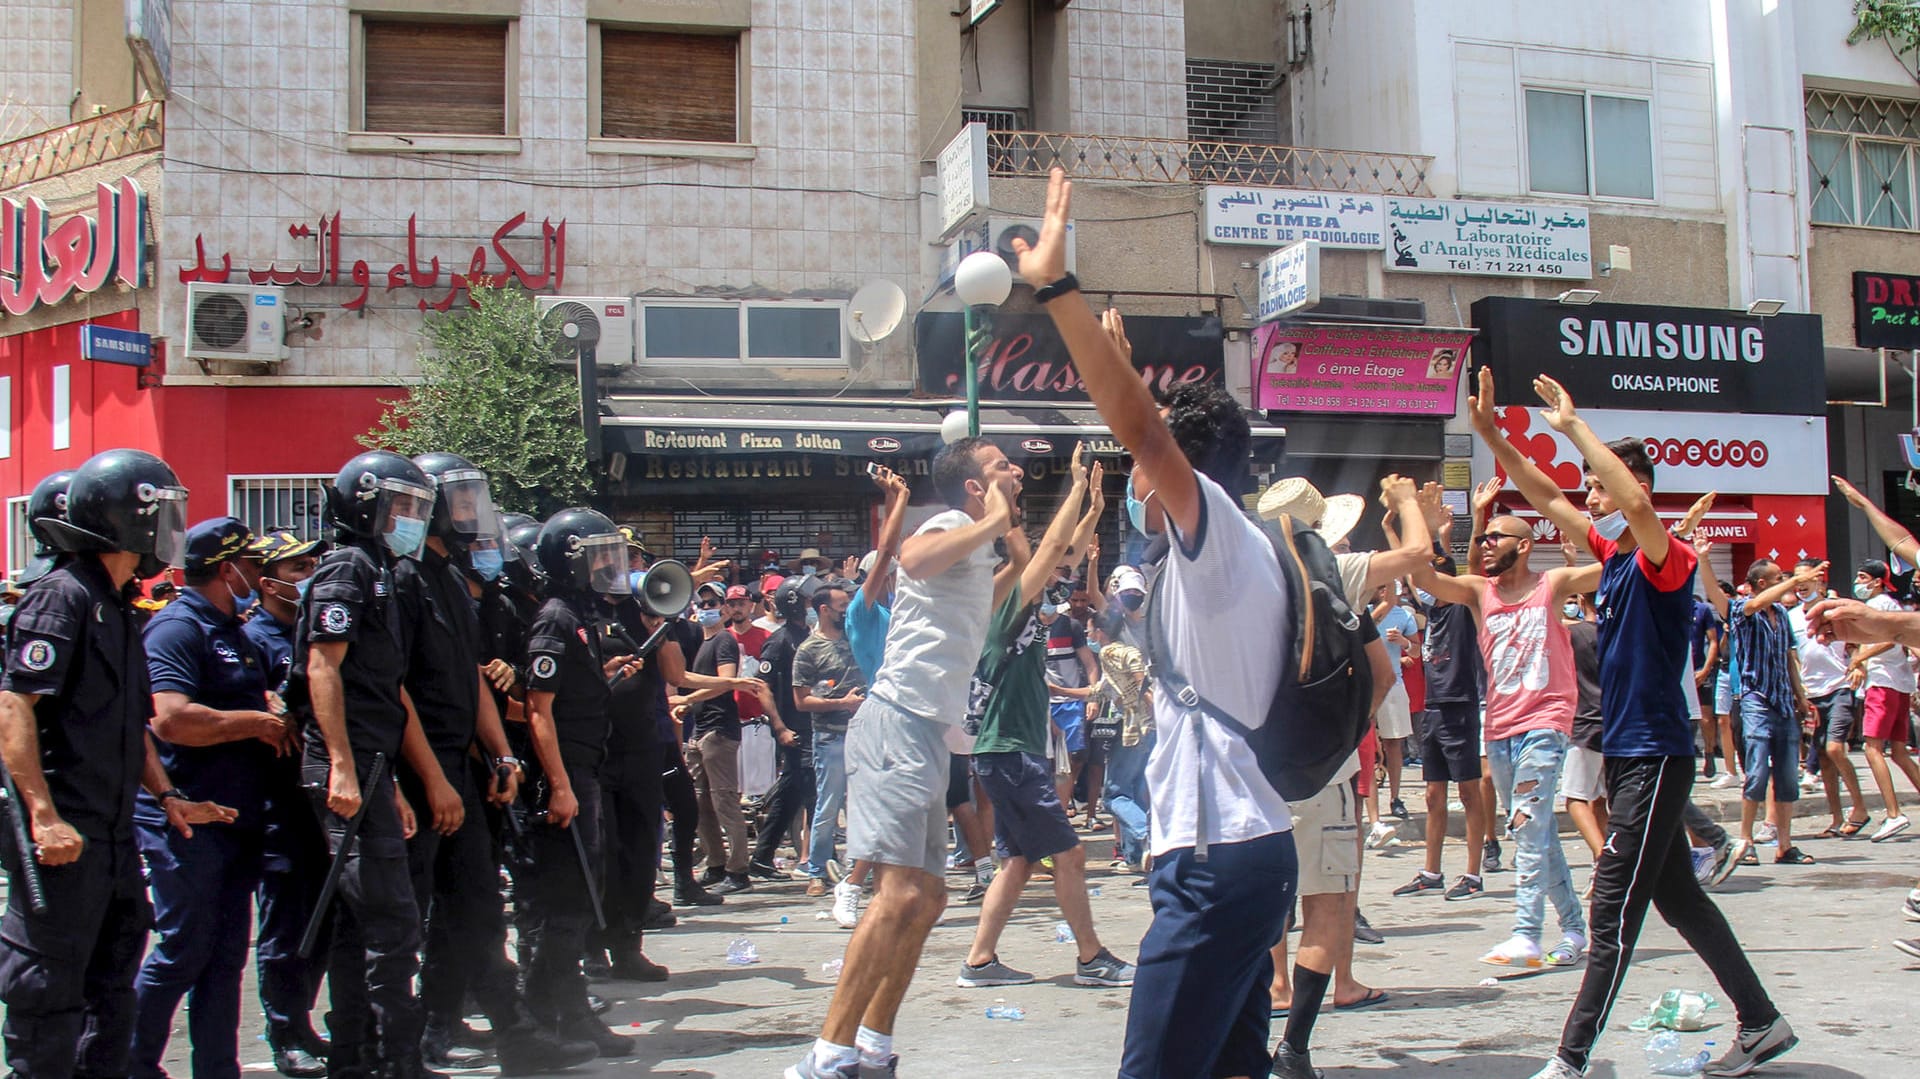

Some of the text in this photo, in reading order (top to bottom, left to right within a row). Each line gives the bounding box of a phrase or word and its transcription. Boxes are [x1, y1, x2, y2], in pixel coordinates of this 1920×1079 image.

[1218, 191, 1374, 214] مركز التصوير الطبي
[1256, 213, 1341, 229] CIMBA
[1389, 201, 1586, 232] مخبر التحاليل الطبية
[1214, 226, 1380, 245] CENTRE DE RADIOLOGIE
[1456, 228, 1552, 246] Laboratoire
[387, 211, 566, 312] الكهرباء
[1506, 245, 1589, 263] Médicales
[1448, 260, 1470, 271] Tél
[1485, 261, 1501, 272] 71
[1508, 263, 1532, 273] 221
[1537, 264, 1563, 275] 450
[1260, 284, 1306, 317] RADIOLOGIE
[1864, 276, 1920, 307] DR
[95, 337, 147, 354] SAMSUNG
[1559, 317, 1765, 363] SAMSUNG
[1304, 343, 1351, 357] Coiffure
[1353, 346, 1366, 357] et
[1317, 360, 1406, 378] 6 ème Étage
[1611, 374, 1720, 393] OKASA PHONE
[1295, 395, 1306, 406] 22
[645, 430, 842, 450] Restaurant Pizza Sultan
[1643, 438, 1765, 464] oredoo
[645, 456, 929, 479] Restaurant Suan
